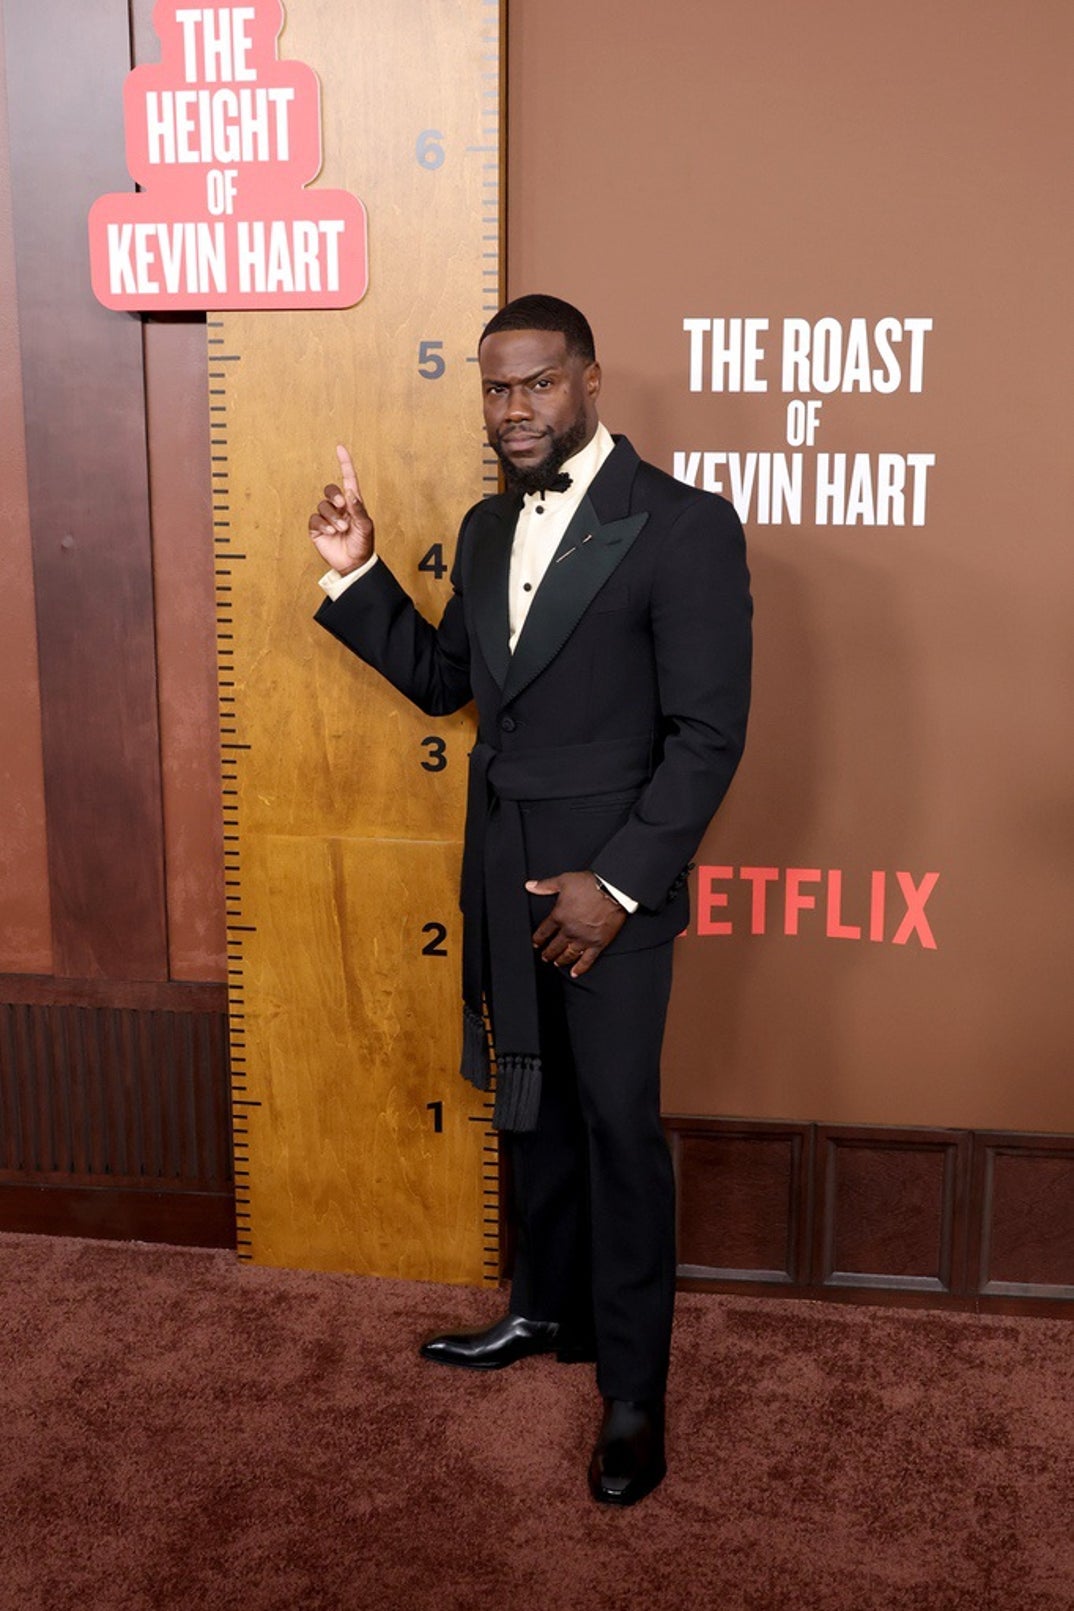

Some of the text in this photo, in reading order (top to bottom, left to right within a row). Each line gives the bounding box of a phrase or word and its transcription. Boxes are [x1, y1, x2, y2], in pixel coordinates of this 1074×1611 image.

[175, 7, 257, 83] THE
[145, 87, 295, 164] HEIGHT
[415, 129, 446, 170] 6
[206, 169, 238, 216] OF
[107, 220, 345, 294] KEVIN HART
[418, 341, 446, 380] 5
[683, 317, 933, 394] THE ROAST
[786, 399, 823, 446] OF
[815, 453, 936, 526] HART
[418, 543, 447, 579] 4
[420, 736, 447, 772] 3
[677, 865, 940, 950] ETFLIX
[421, 922, 448, 957] 2
[426, 1101, 443, 1133] 1
